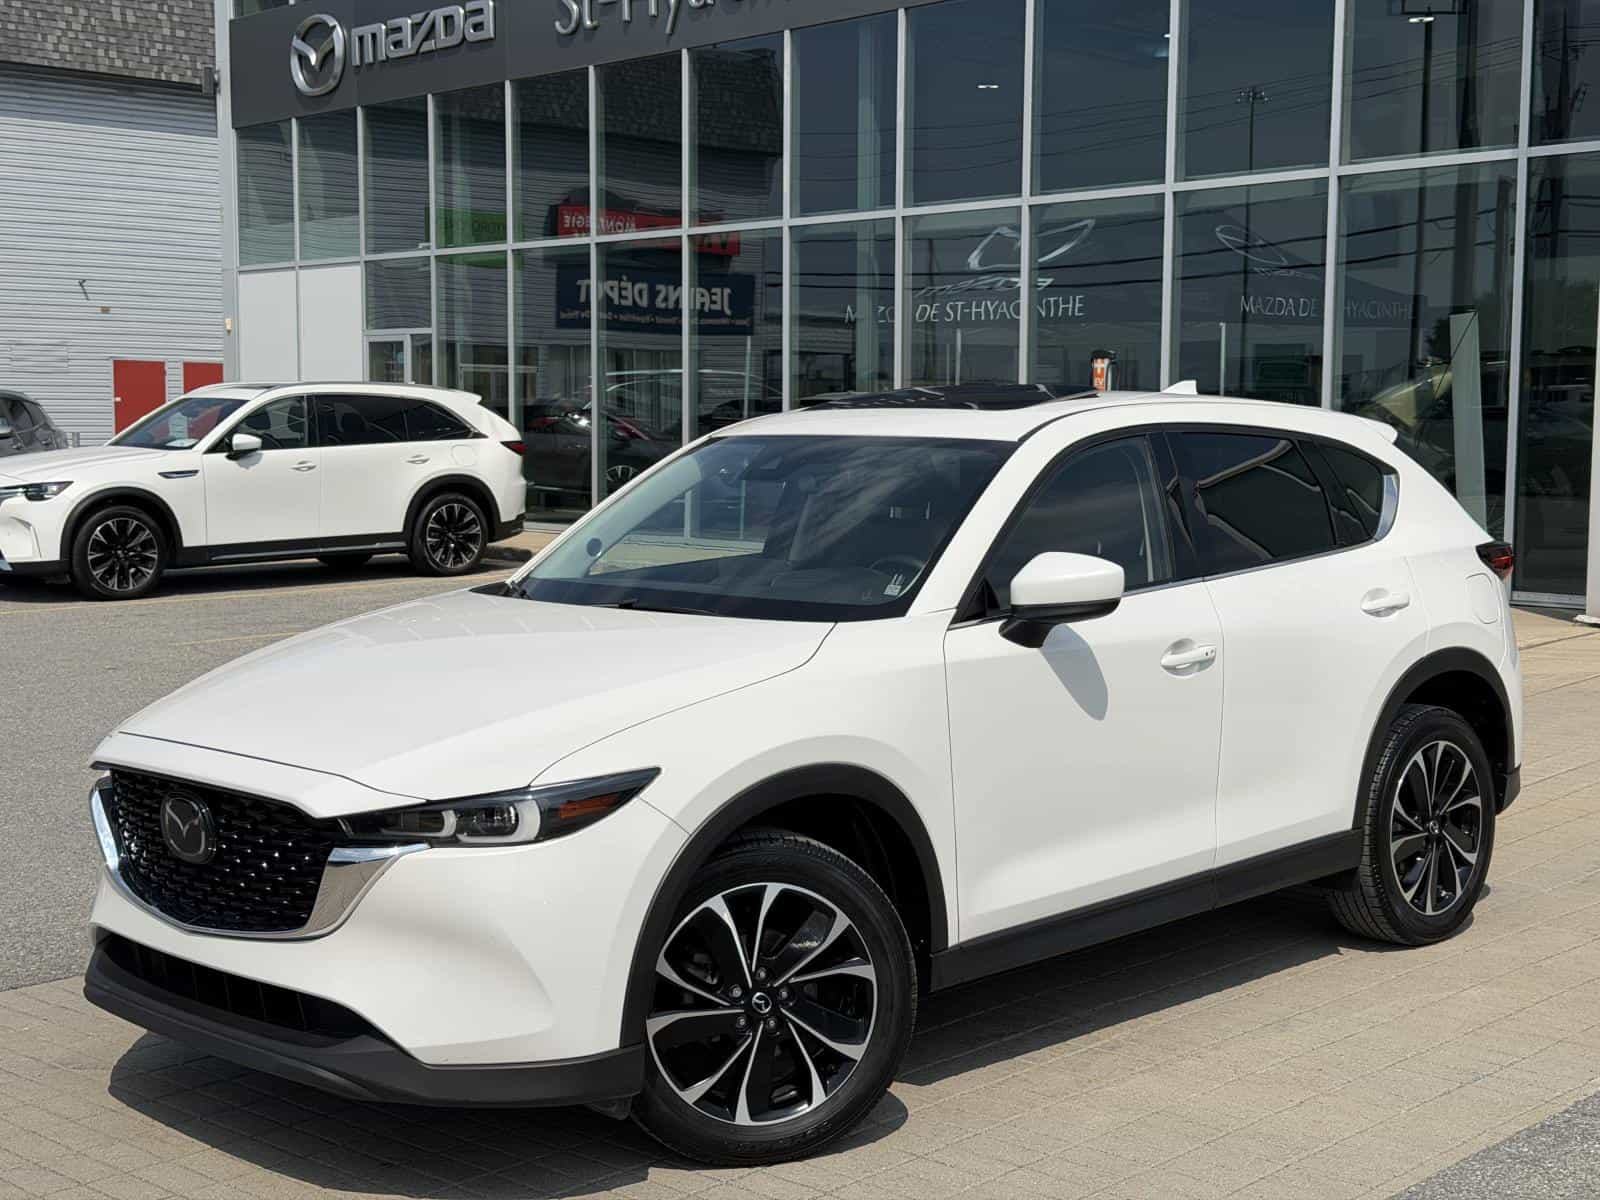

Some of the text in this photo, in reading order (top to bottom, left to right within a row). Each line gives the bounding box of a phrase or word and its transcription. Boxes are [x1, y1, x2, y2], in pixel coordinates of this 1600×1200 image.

[915, 302, 940, 322] DE
[944, 295, 1085, 322] ST-HYACNTHE
[1240, 296, 1296, 317] MAZDA
[1298, 297, 1320, 317] DE
